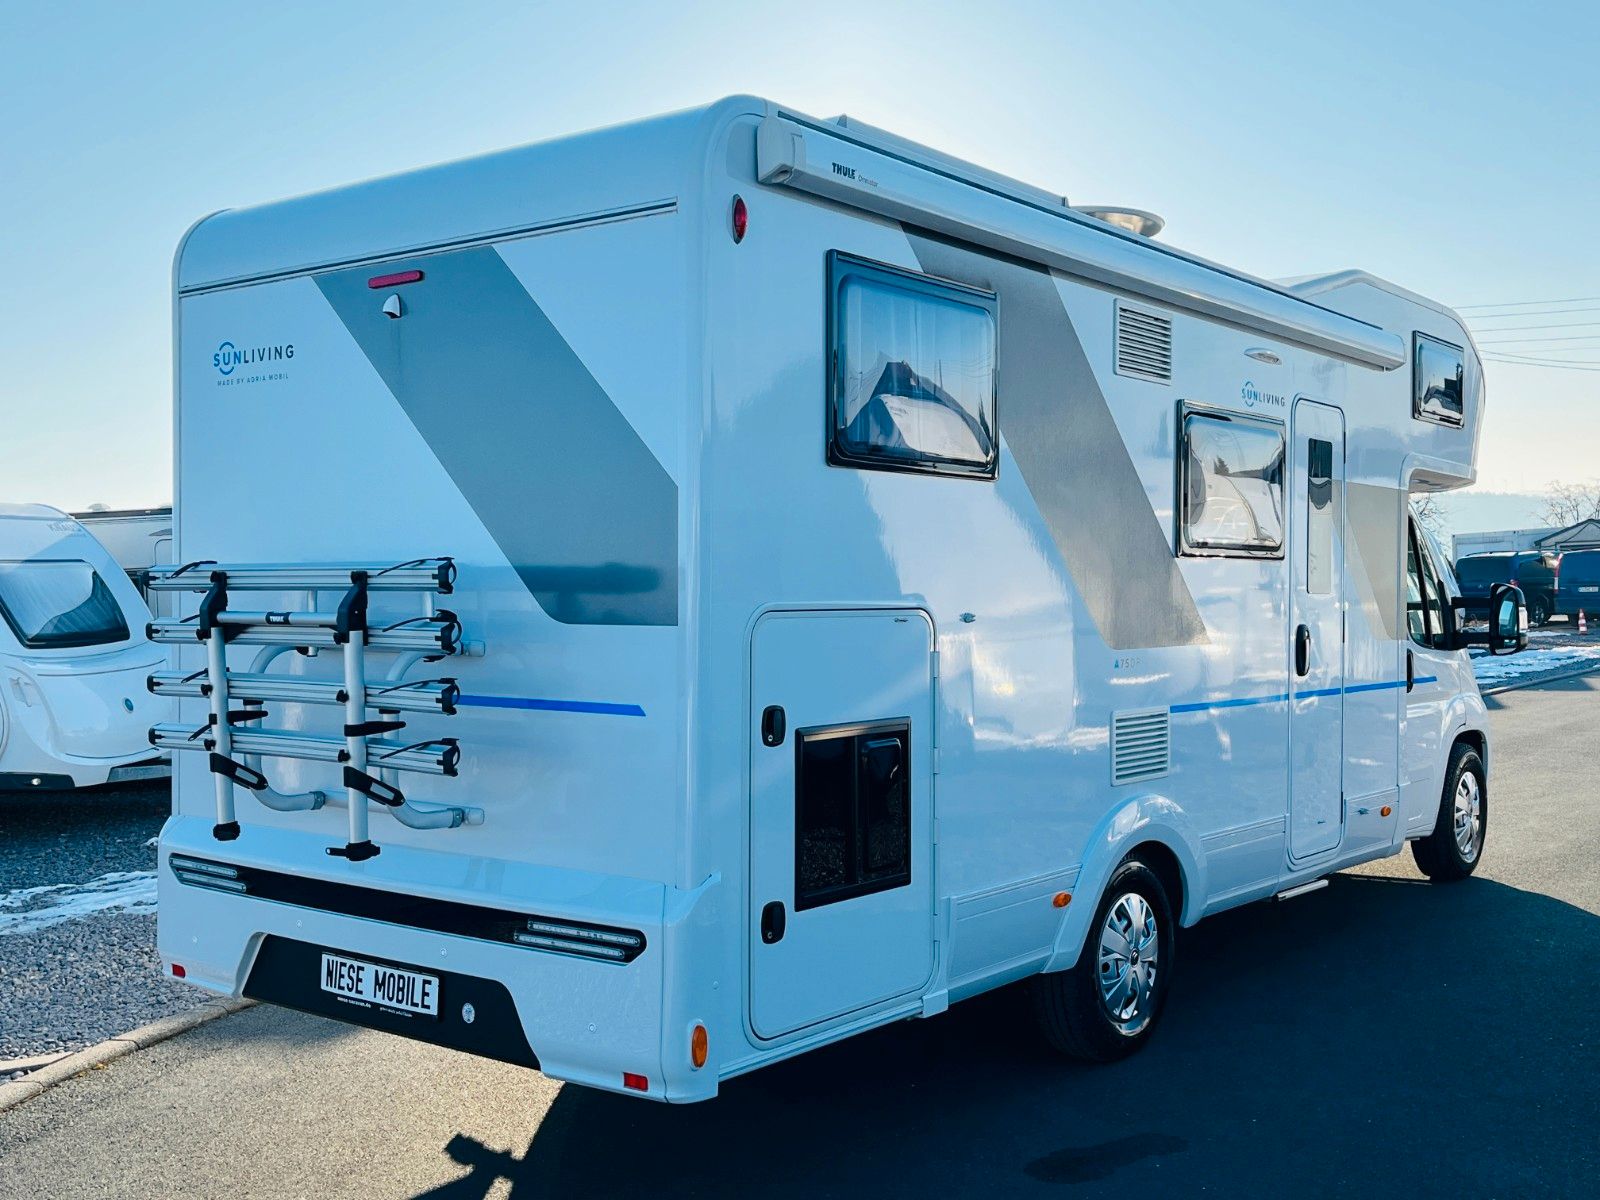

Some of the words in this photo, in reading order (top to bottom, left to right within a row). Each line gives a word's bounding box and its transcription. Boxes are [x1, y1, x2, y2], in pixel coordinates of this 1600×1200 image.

[832, 162, 856, 180] THULE
[213, 344, 294, 367] SUNLIVING
[1242, 388, 1286, 407] SUNLIVING
[326, 958, 365, 995] NIESE
[373, 969, 432, 1010] MOBILE
